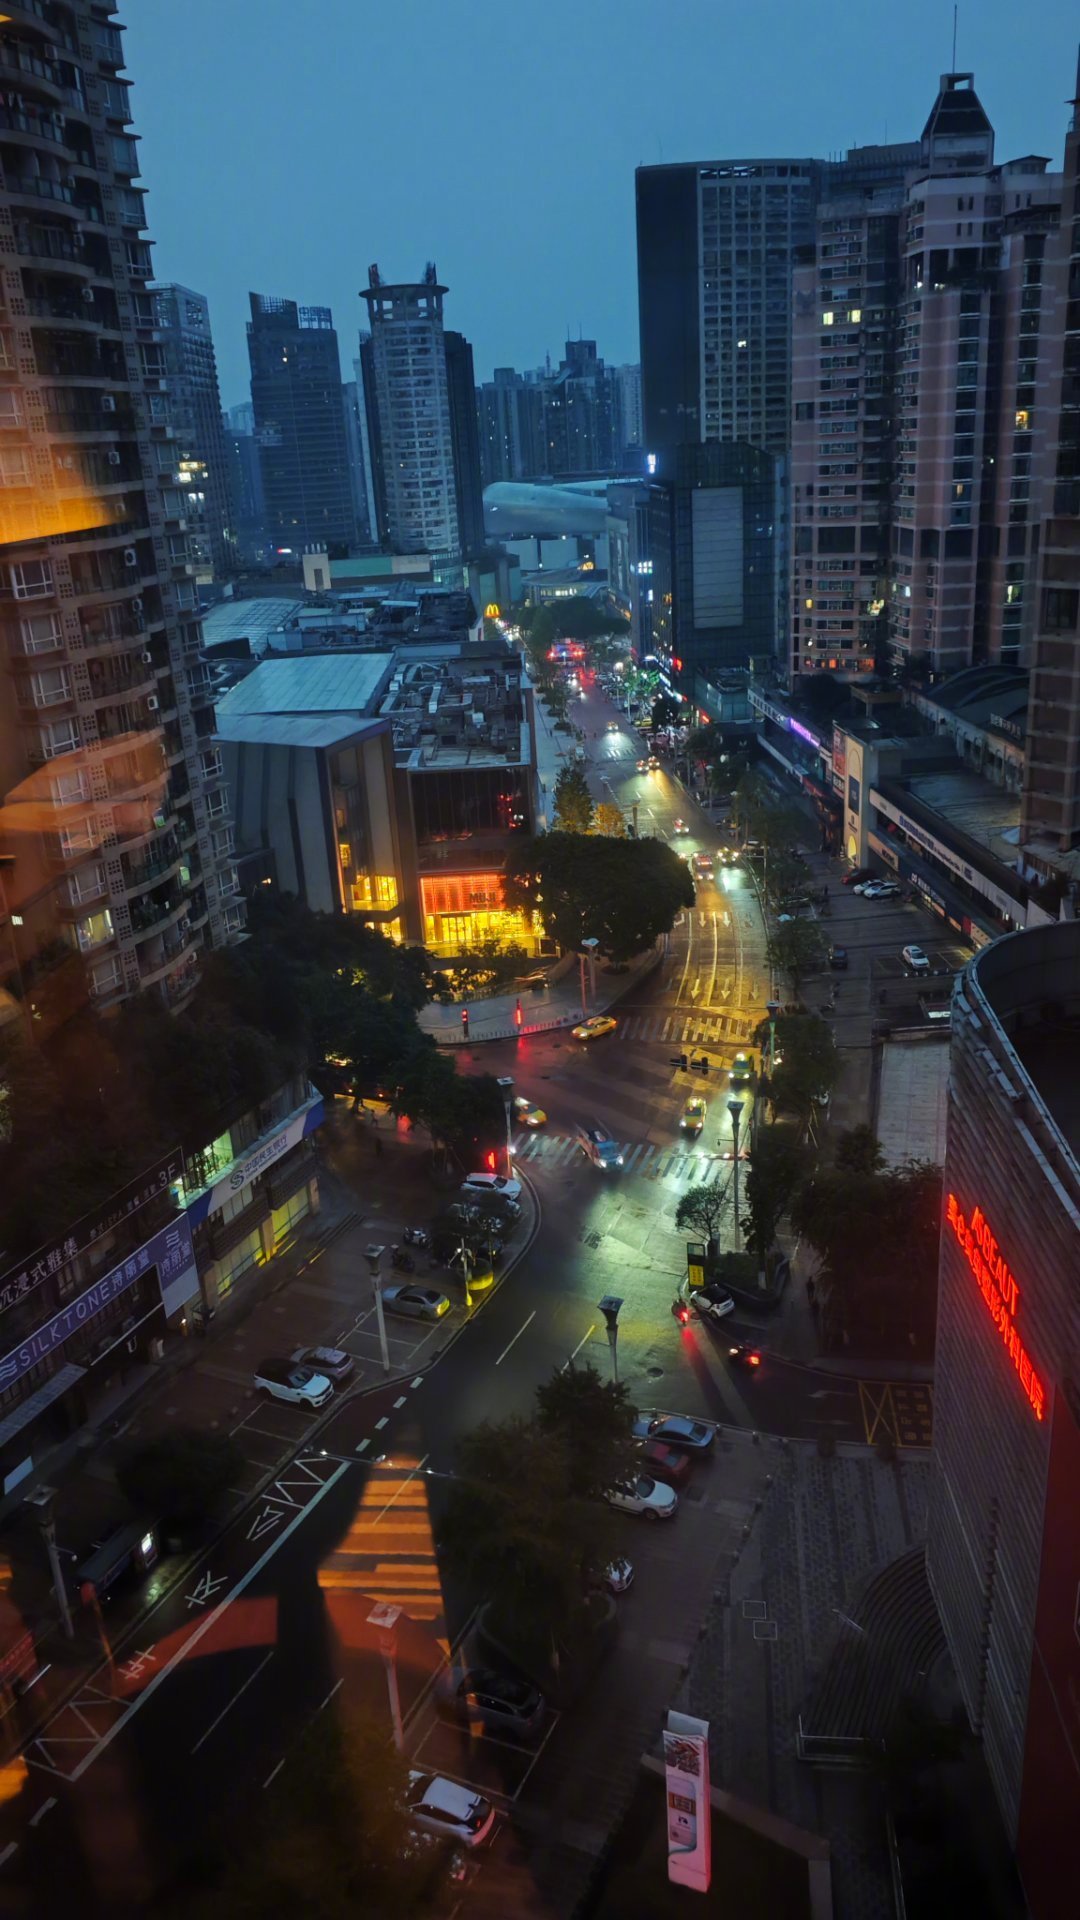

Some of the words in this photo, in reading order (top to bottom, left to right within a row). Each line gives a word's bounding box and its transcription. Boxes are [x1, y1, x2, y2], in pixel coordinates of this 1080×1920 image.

[470, 892, 496, 903] MUJI
[158, 1162, 176, 1187] 3F
[19, 1281, 110, 1367] SILKTONE
